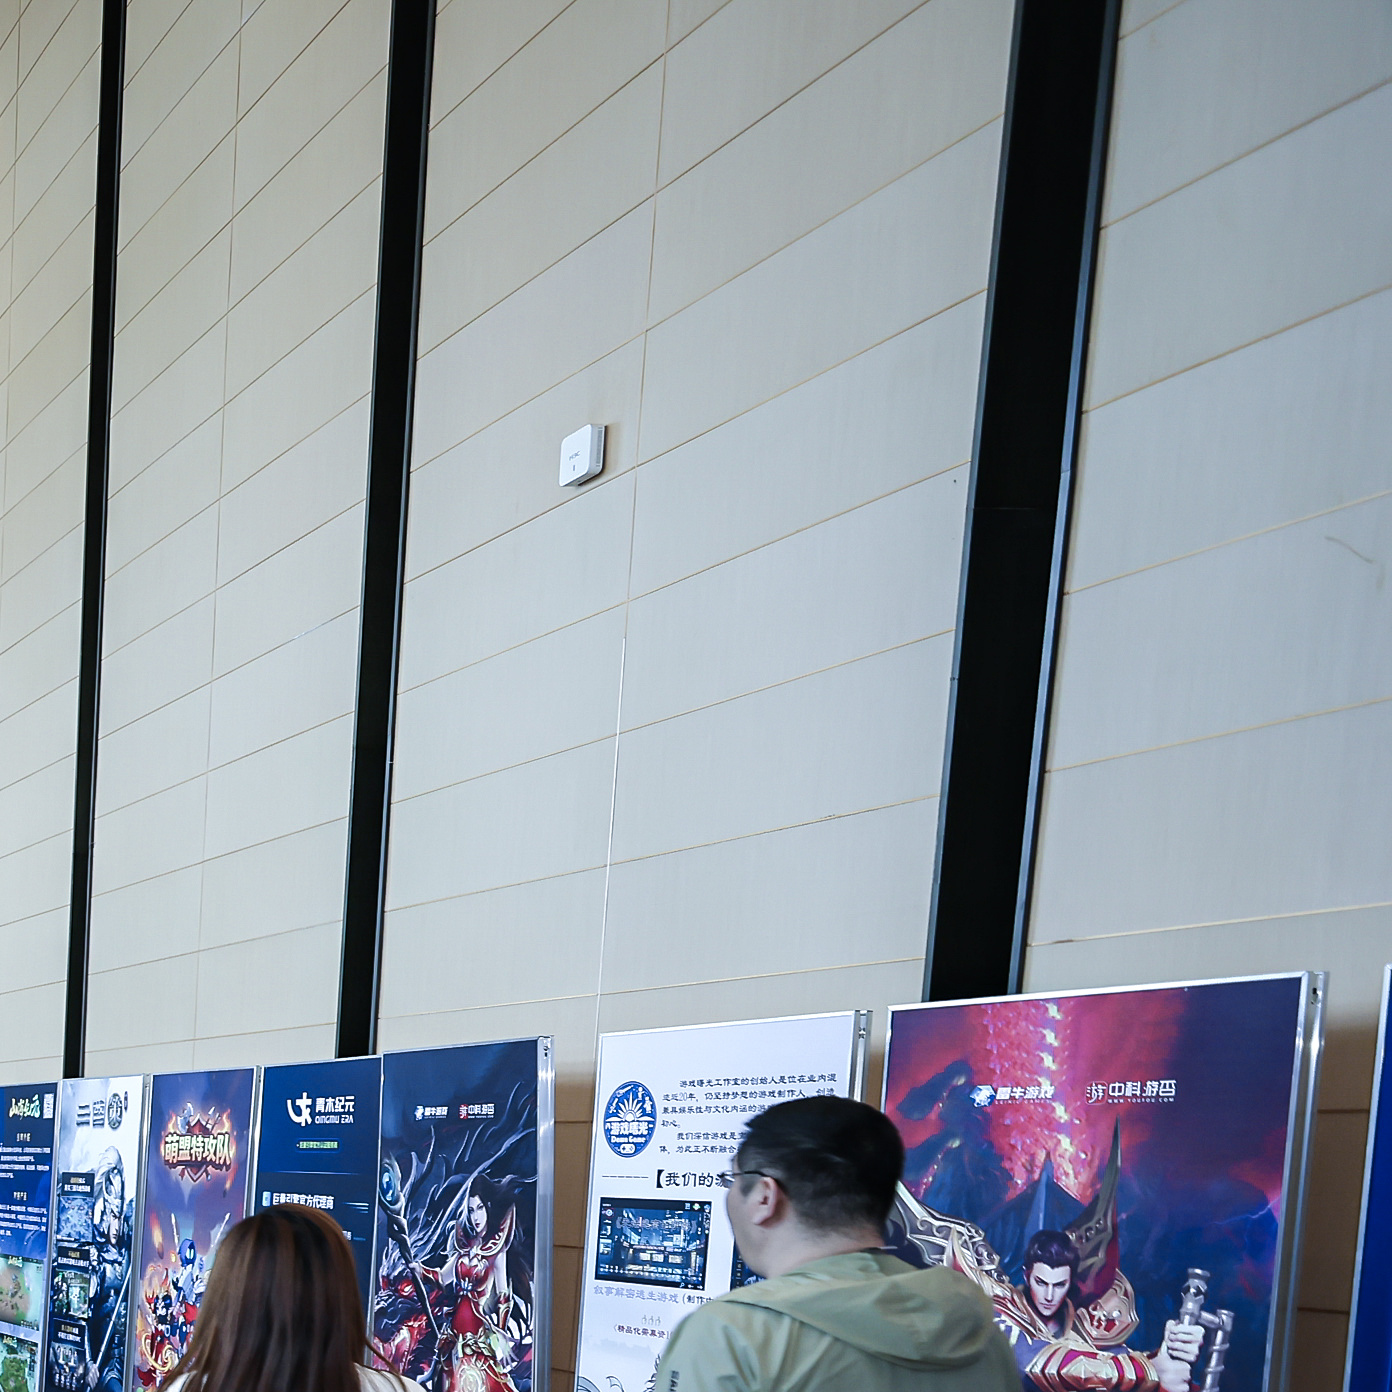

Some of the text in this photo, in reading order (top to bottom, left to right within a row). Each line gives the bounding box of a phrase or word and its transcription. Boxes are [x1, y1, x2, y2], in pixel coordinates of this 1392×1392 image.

[316, 1096, 355, 1113] 青木纪元
[661, 1103, 775, 1115] 兼具娱乐性与文化内涵的游
[165, 1133, 231, 1164] 萌盟特攻队
